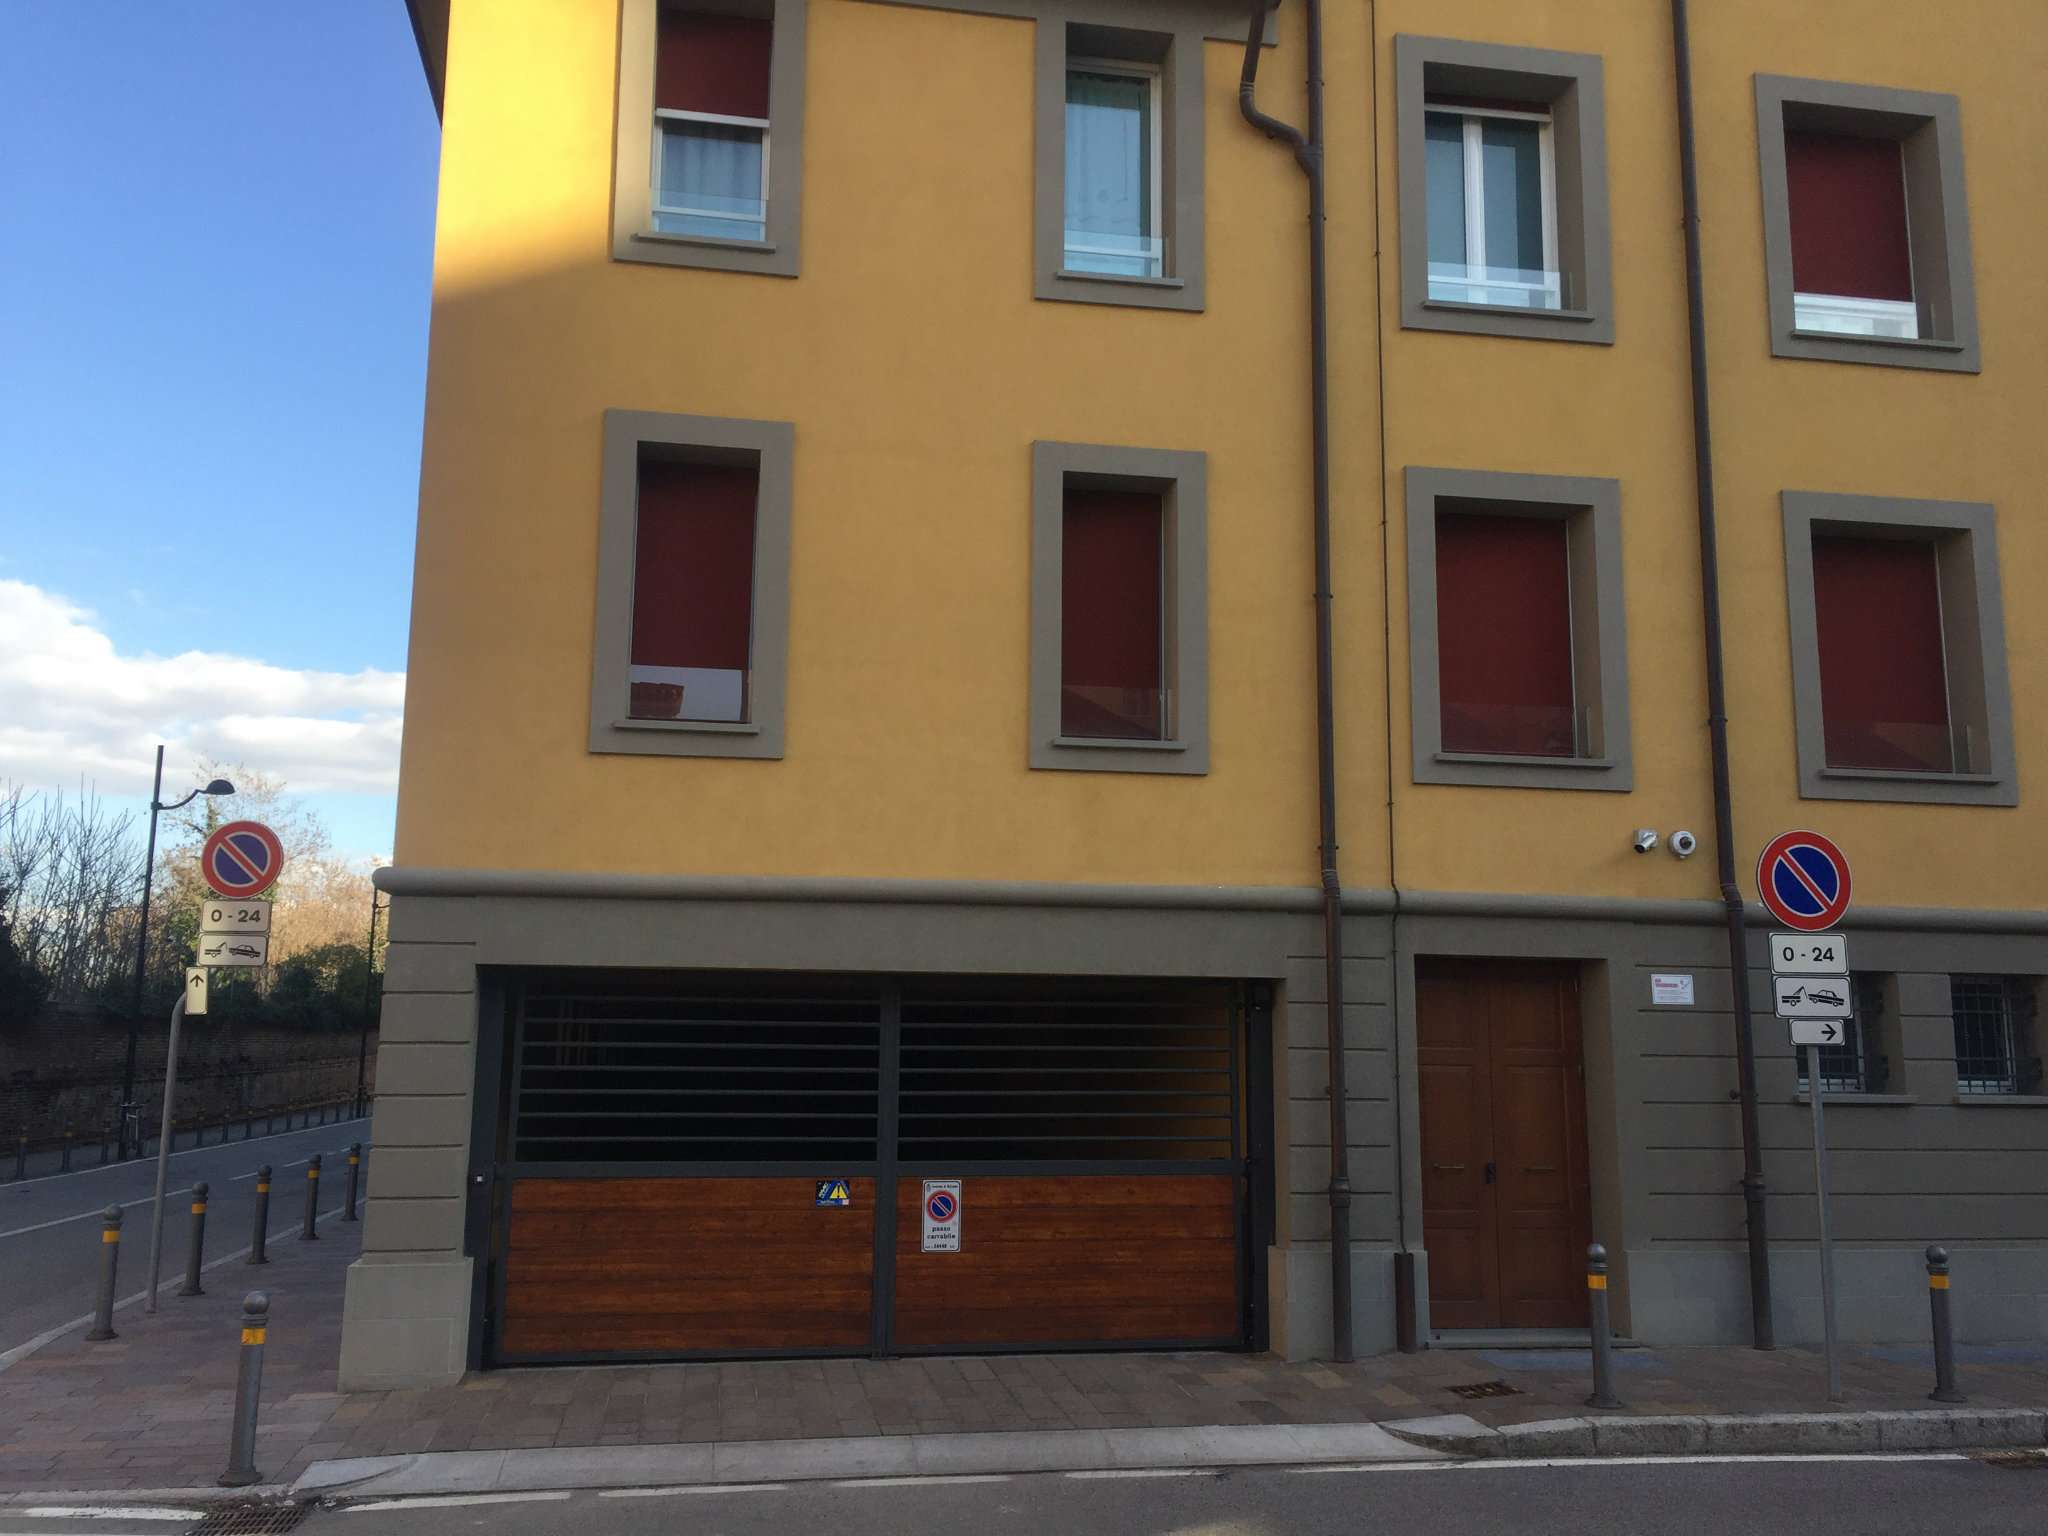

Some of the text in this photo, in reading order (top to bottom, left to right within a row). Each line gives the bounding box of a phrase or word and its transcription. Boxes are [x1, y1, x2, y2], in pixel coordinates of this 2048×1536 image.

[211, 909, 222, 922] 0
[238, 909, 261, 922] 24
[1782, 947, 1795, 962] 0
[1812, 947, 1835, 962] 24
